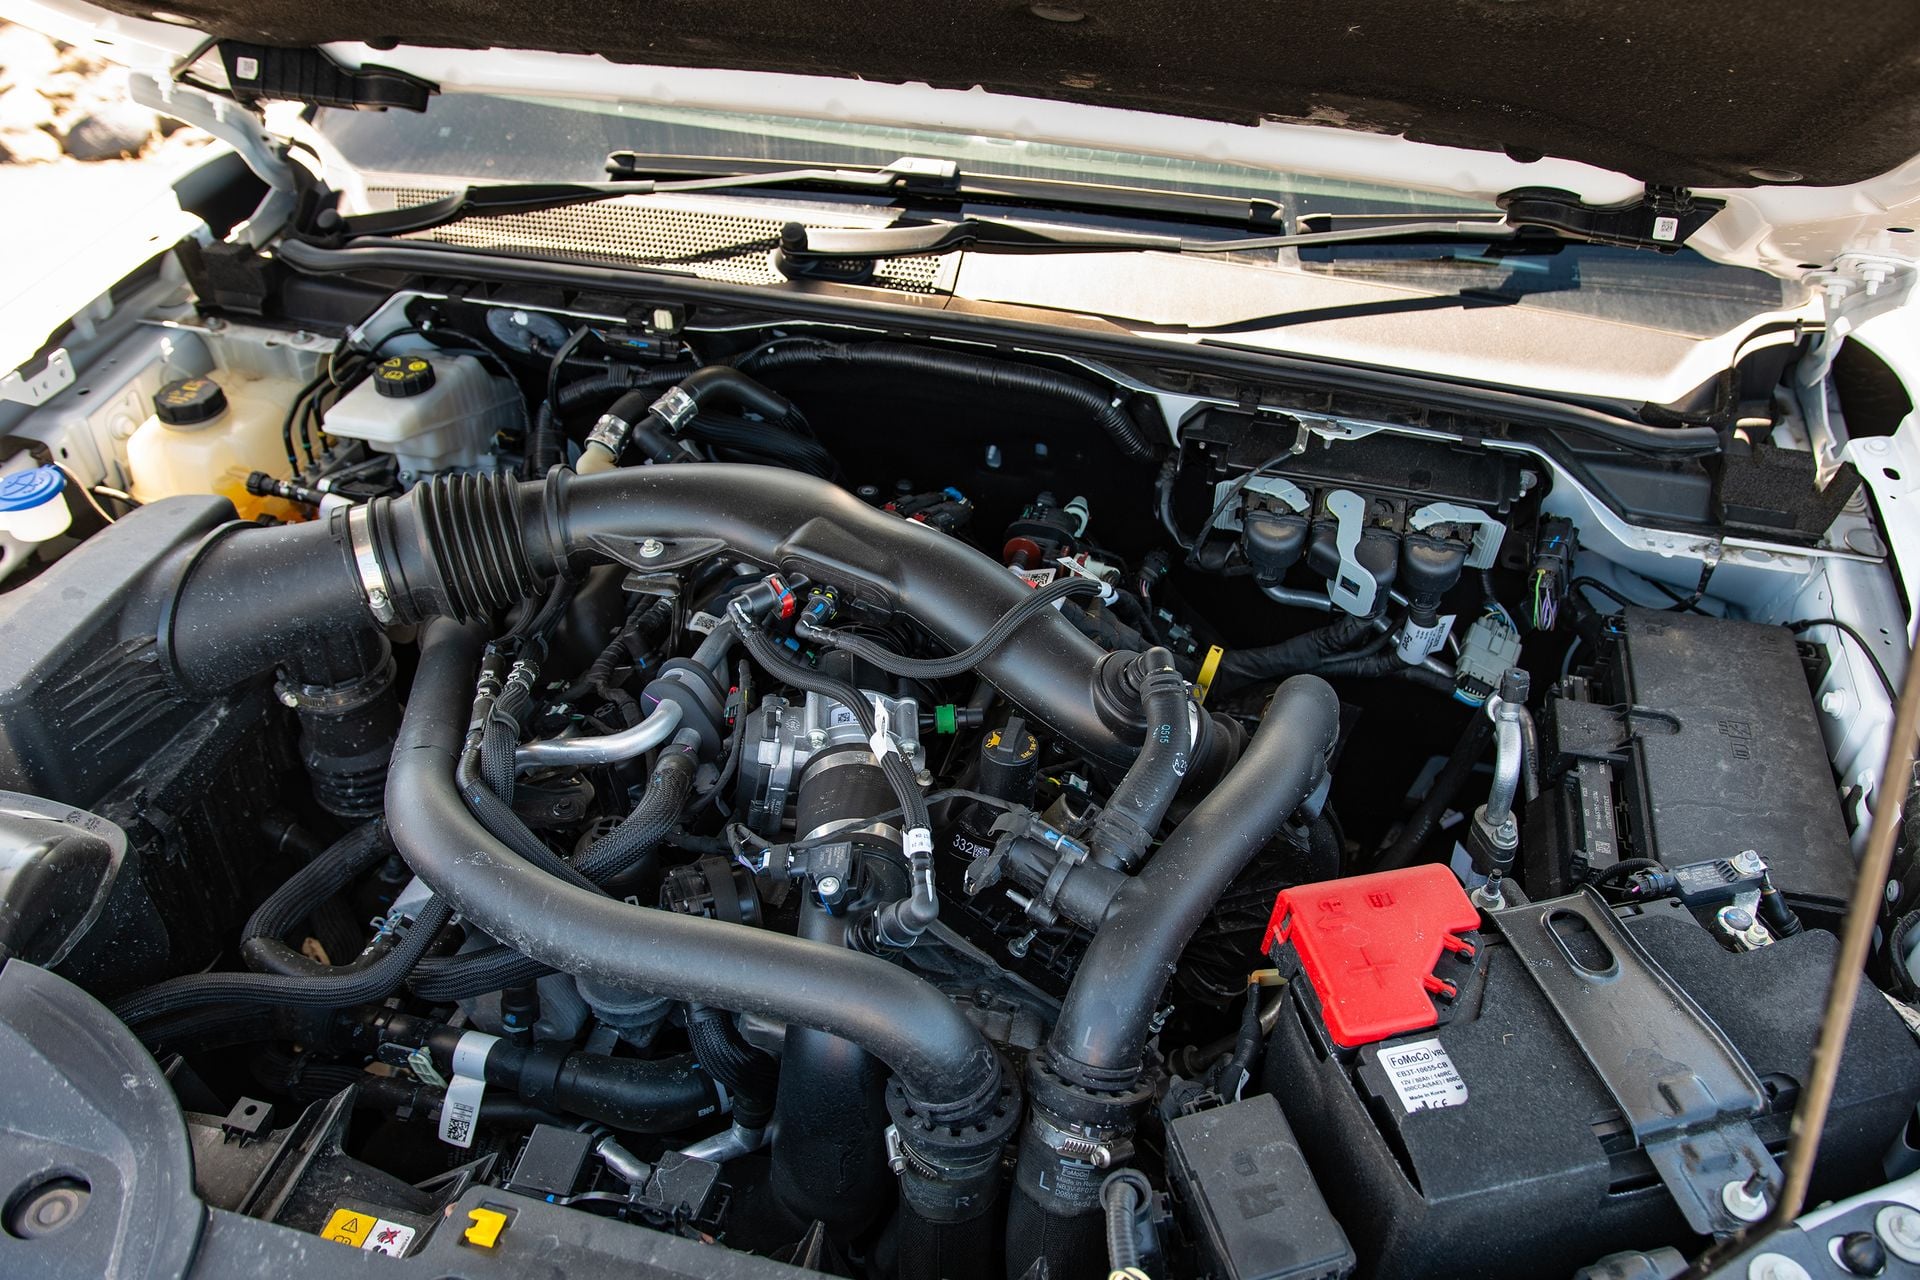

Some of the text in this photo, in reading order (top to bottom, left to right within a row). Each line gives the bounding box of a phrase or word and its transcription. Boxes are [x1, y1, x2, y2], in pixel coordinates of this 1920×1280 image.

[953, 834, 973, 854] 332
[1390, 1052, 1430, 1067] FoMoCo
[1039, 1171, 1050, 1191] L
